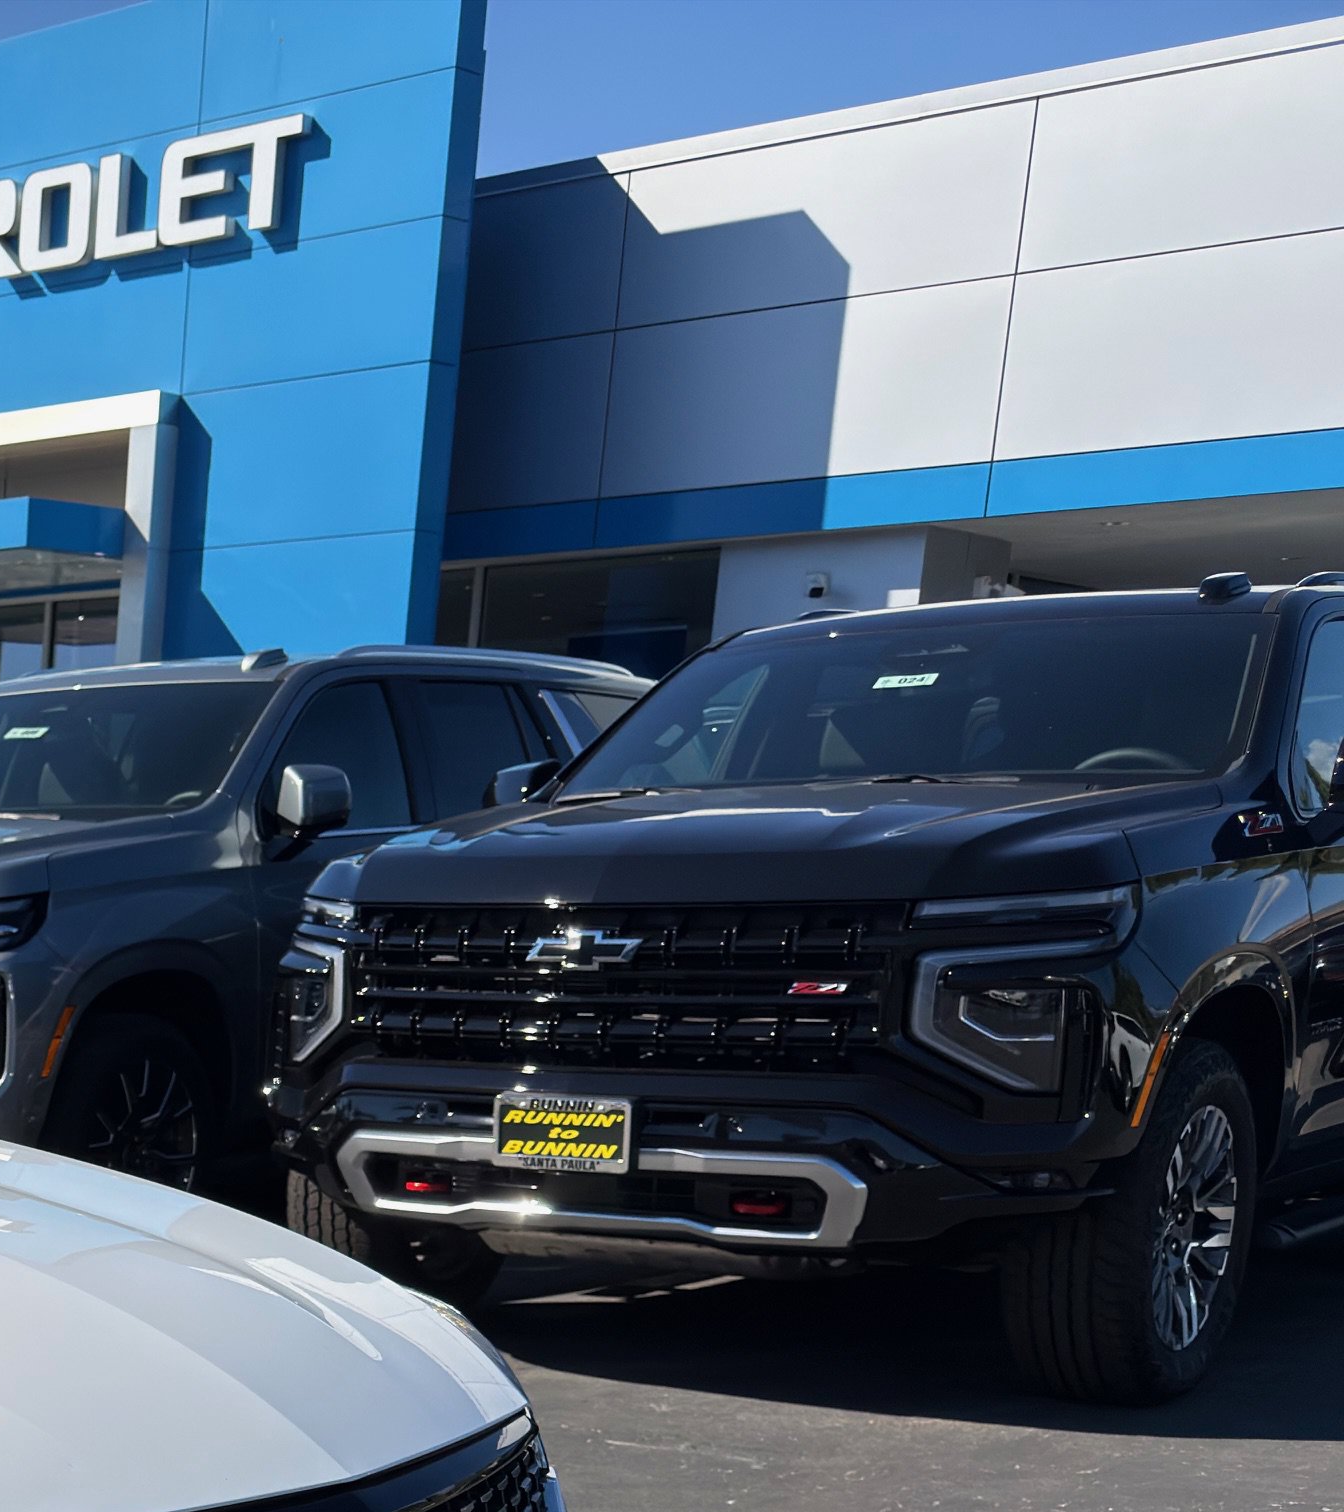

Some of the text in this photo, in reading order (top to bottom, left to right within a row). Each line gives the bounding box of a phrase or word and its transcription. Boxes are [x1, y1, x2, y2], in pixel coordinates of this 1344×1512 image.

[529, 1098, 595, 1112] BUNNIN
[502, 1109, 625, 1128] RUNNIN'
[548, 1126, 580, 1140] to
[501, 1139, 618, 1159] BUNNIN
